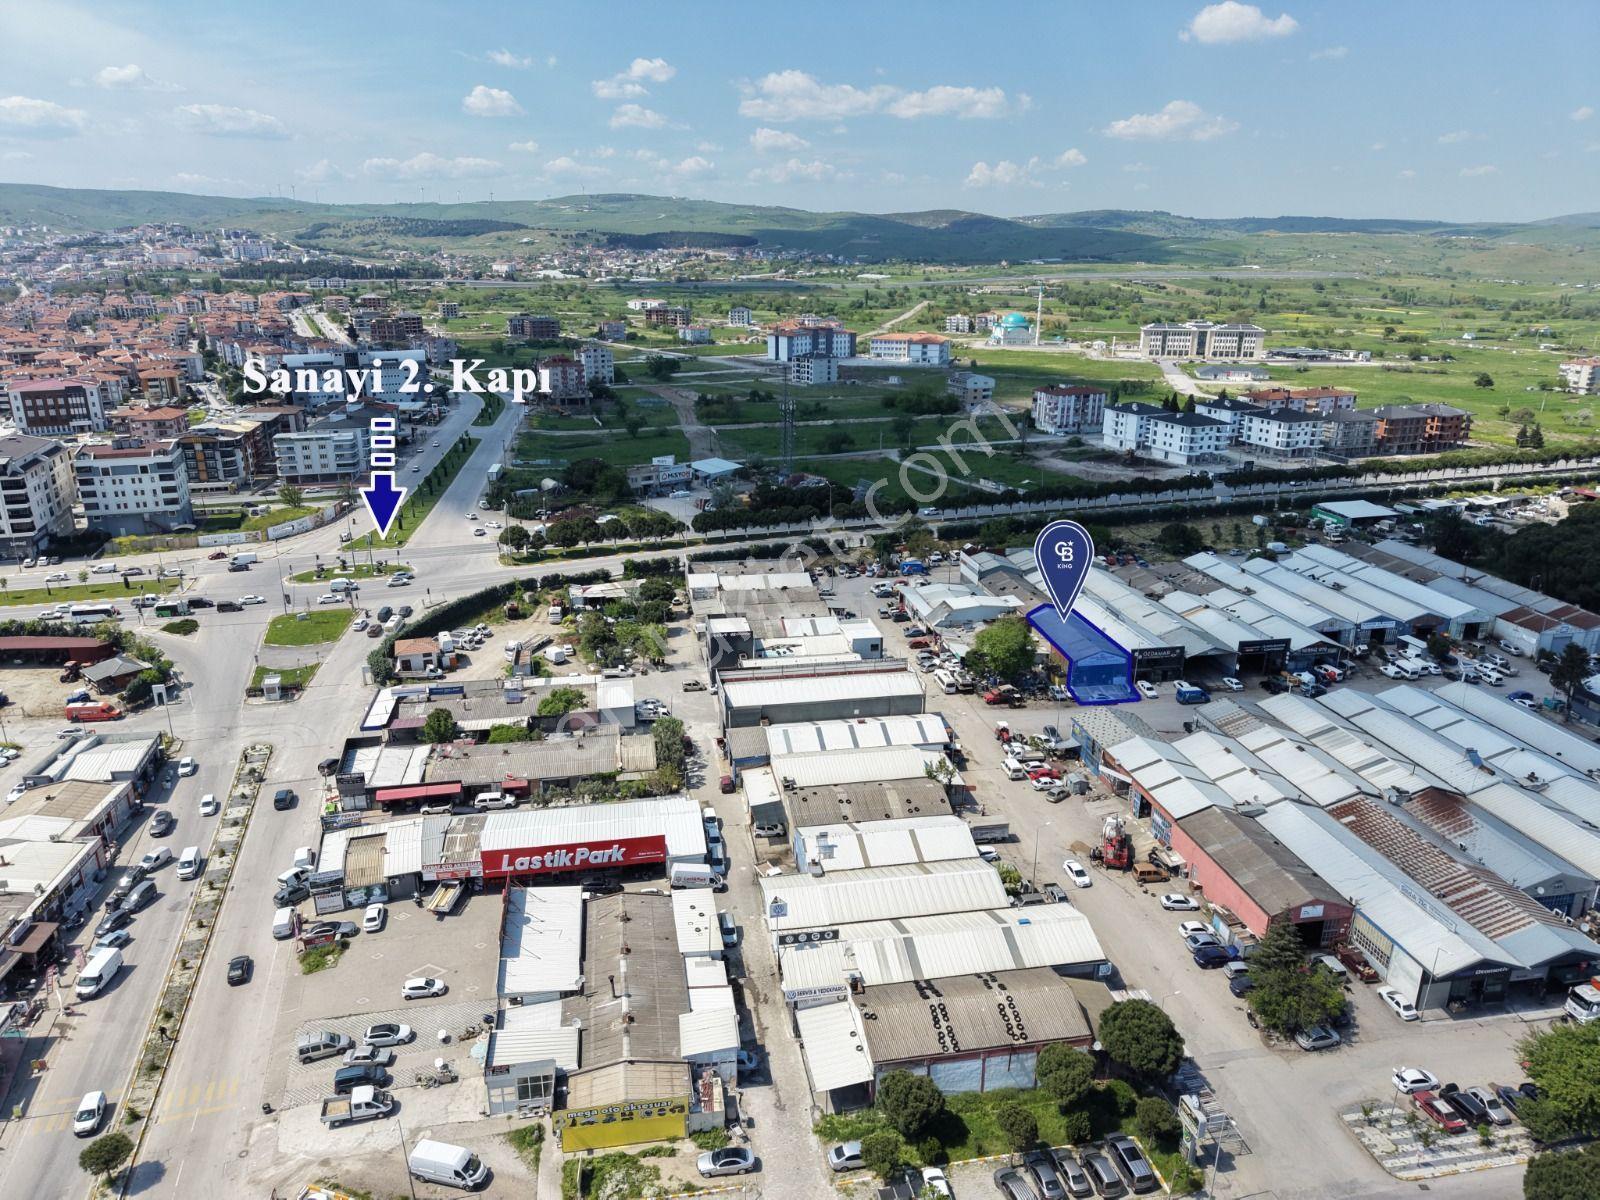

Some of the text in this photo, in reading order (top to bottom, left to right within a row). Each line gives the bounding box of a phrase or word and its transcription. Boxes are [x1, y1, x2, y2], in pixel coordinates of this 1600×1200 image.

[567, 1100, 673, 1119] mega oto aksesuar
